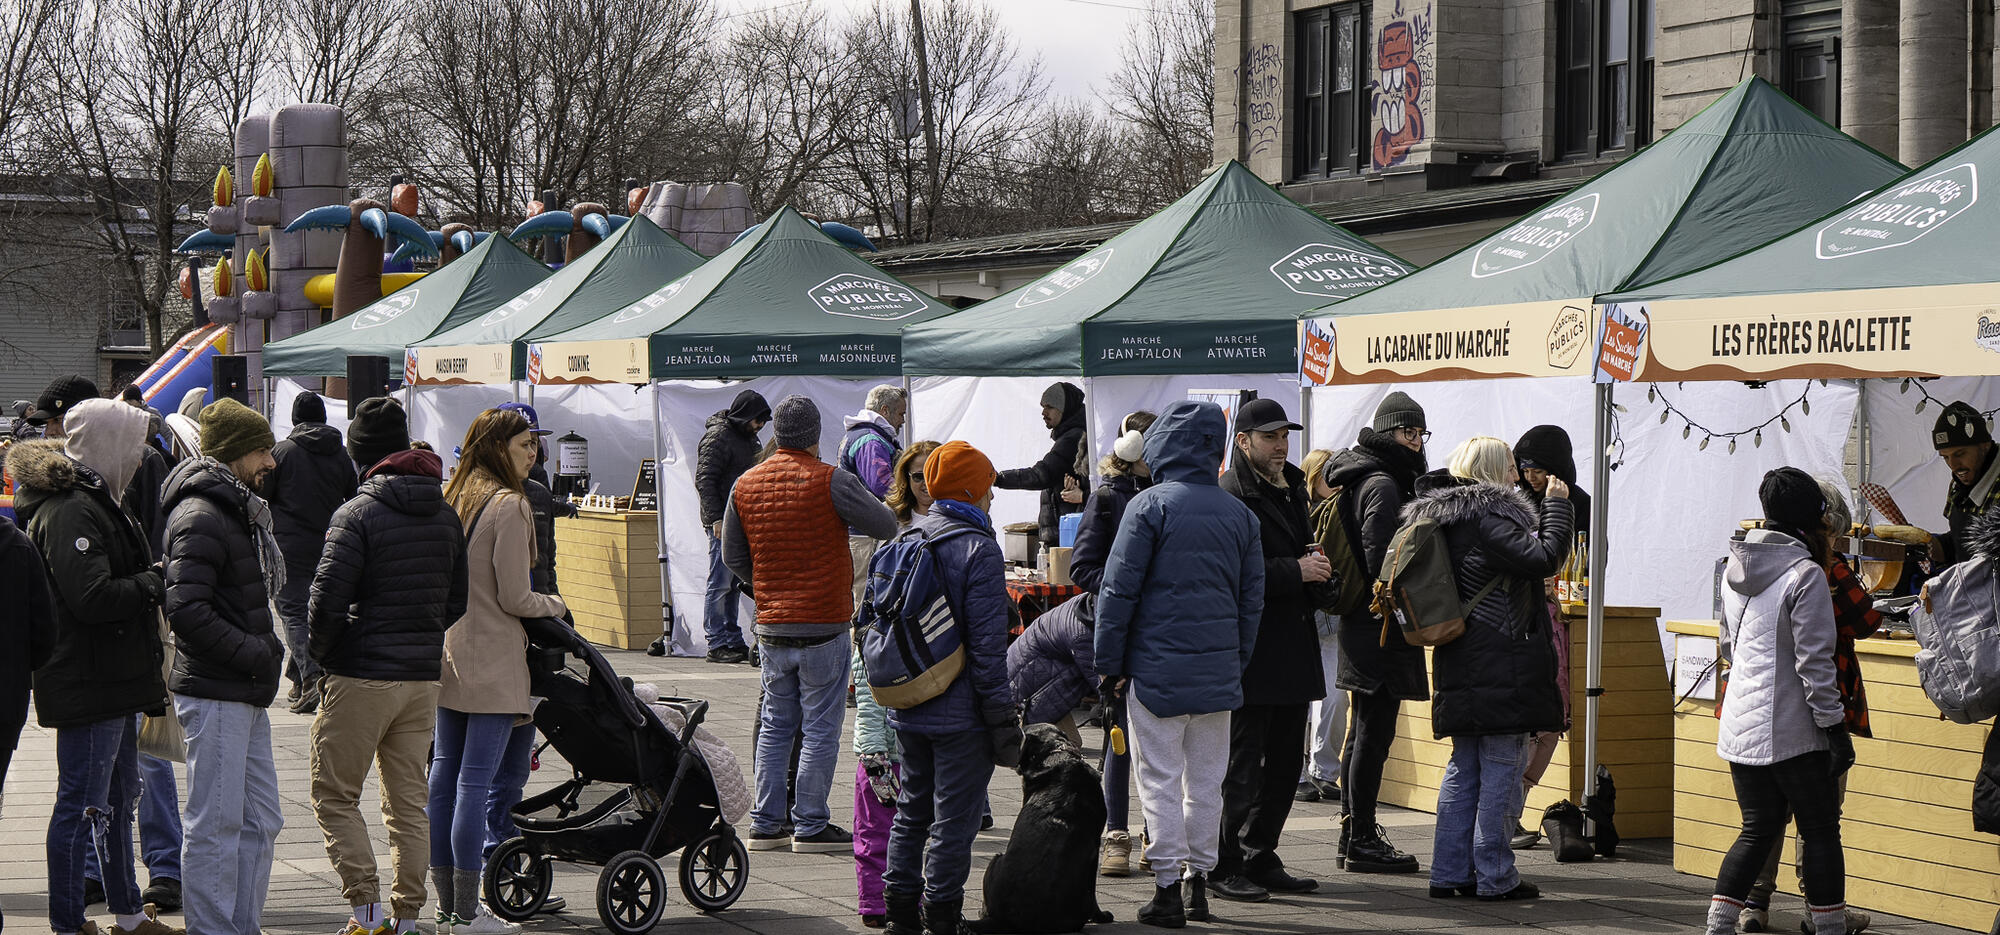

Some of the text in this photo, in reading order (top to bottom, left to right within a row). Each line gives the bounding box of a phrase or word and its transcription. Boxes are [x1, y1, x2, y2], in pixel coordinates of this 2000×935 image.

[1893, 179, 1966, 205] MARCHÉS
[1848, 203, 1947, 228] PUBLICS
[1501, 225, 1570, 249] PUBLICS
[1291, 252, 1370, 269] MARCHÉS
[1287, 265, 1399, 284] PUBLICS
[826, 281, 890, 294] MARCHÉS
[820, 292, 912, 306] PUBLICS
[1122, 336, 1161, 344] MARCHÉ
[1215, 335, 1257, 344] MARCHÉ
[1368, 320, 1510, 363] LA CABANE DU MARCHÉ
[1550, 321, 1584, 355] PUBLICS
[1712, 314, 1911, 357] LES FRÈRES RACLETTE
[682, 345, 714, 353] MARCHÉ
[757, 344, 791, 352] MARCHÉ
[840, 343, 875, 351] MARCHÉ
[1101, 348, 1182, 360] JEAN-TALON
[1207, 347, 1267, 358] ATWATER
[568, 354, 590, 372] COOKINE
[665, 354, 731, 365] JEAN-TALON
[751, 353, 798, 364] ATWATER
[819, 352, 896, 363] MAISONNEUVE
[1609, 354, 1632, 373] MARCHÉ
[436, 358, 468, 374] MAISON BERRY
